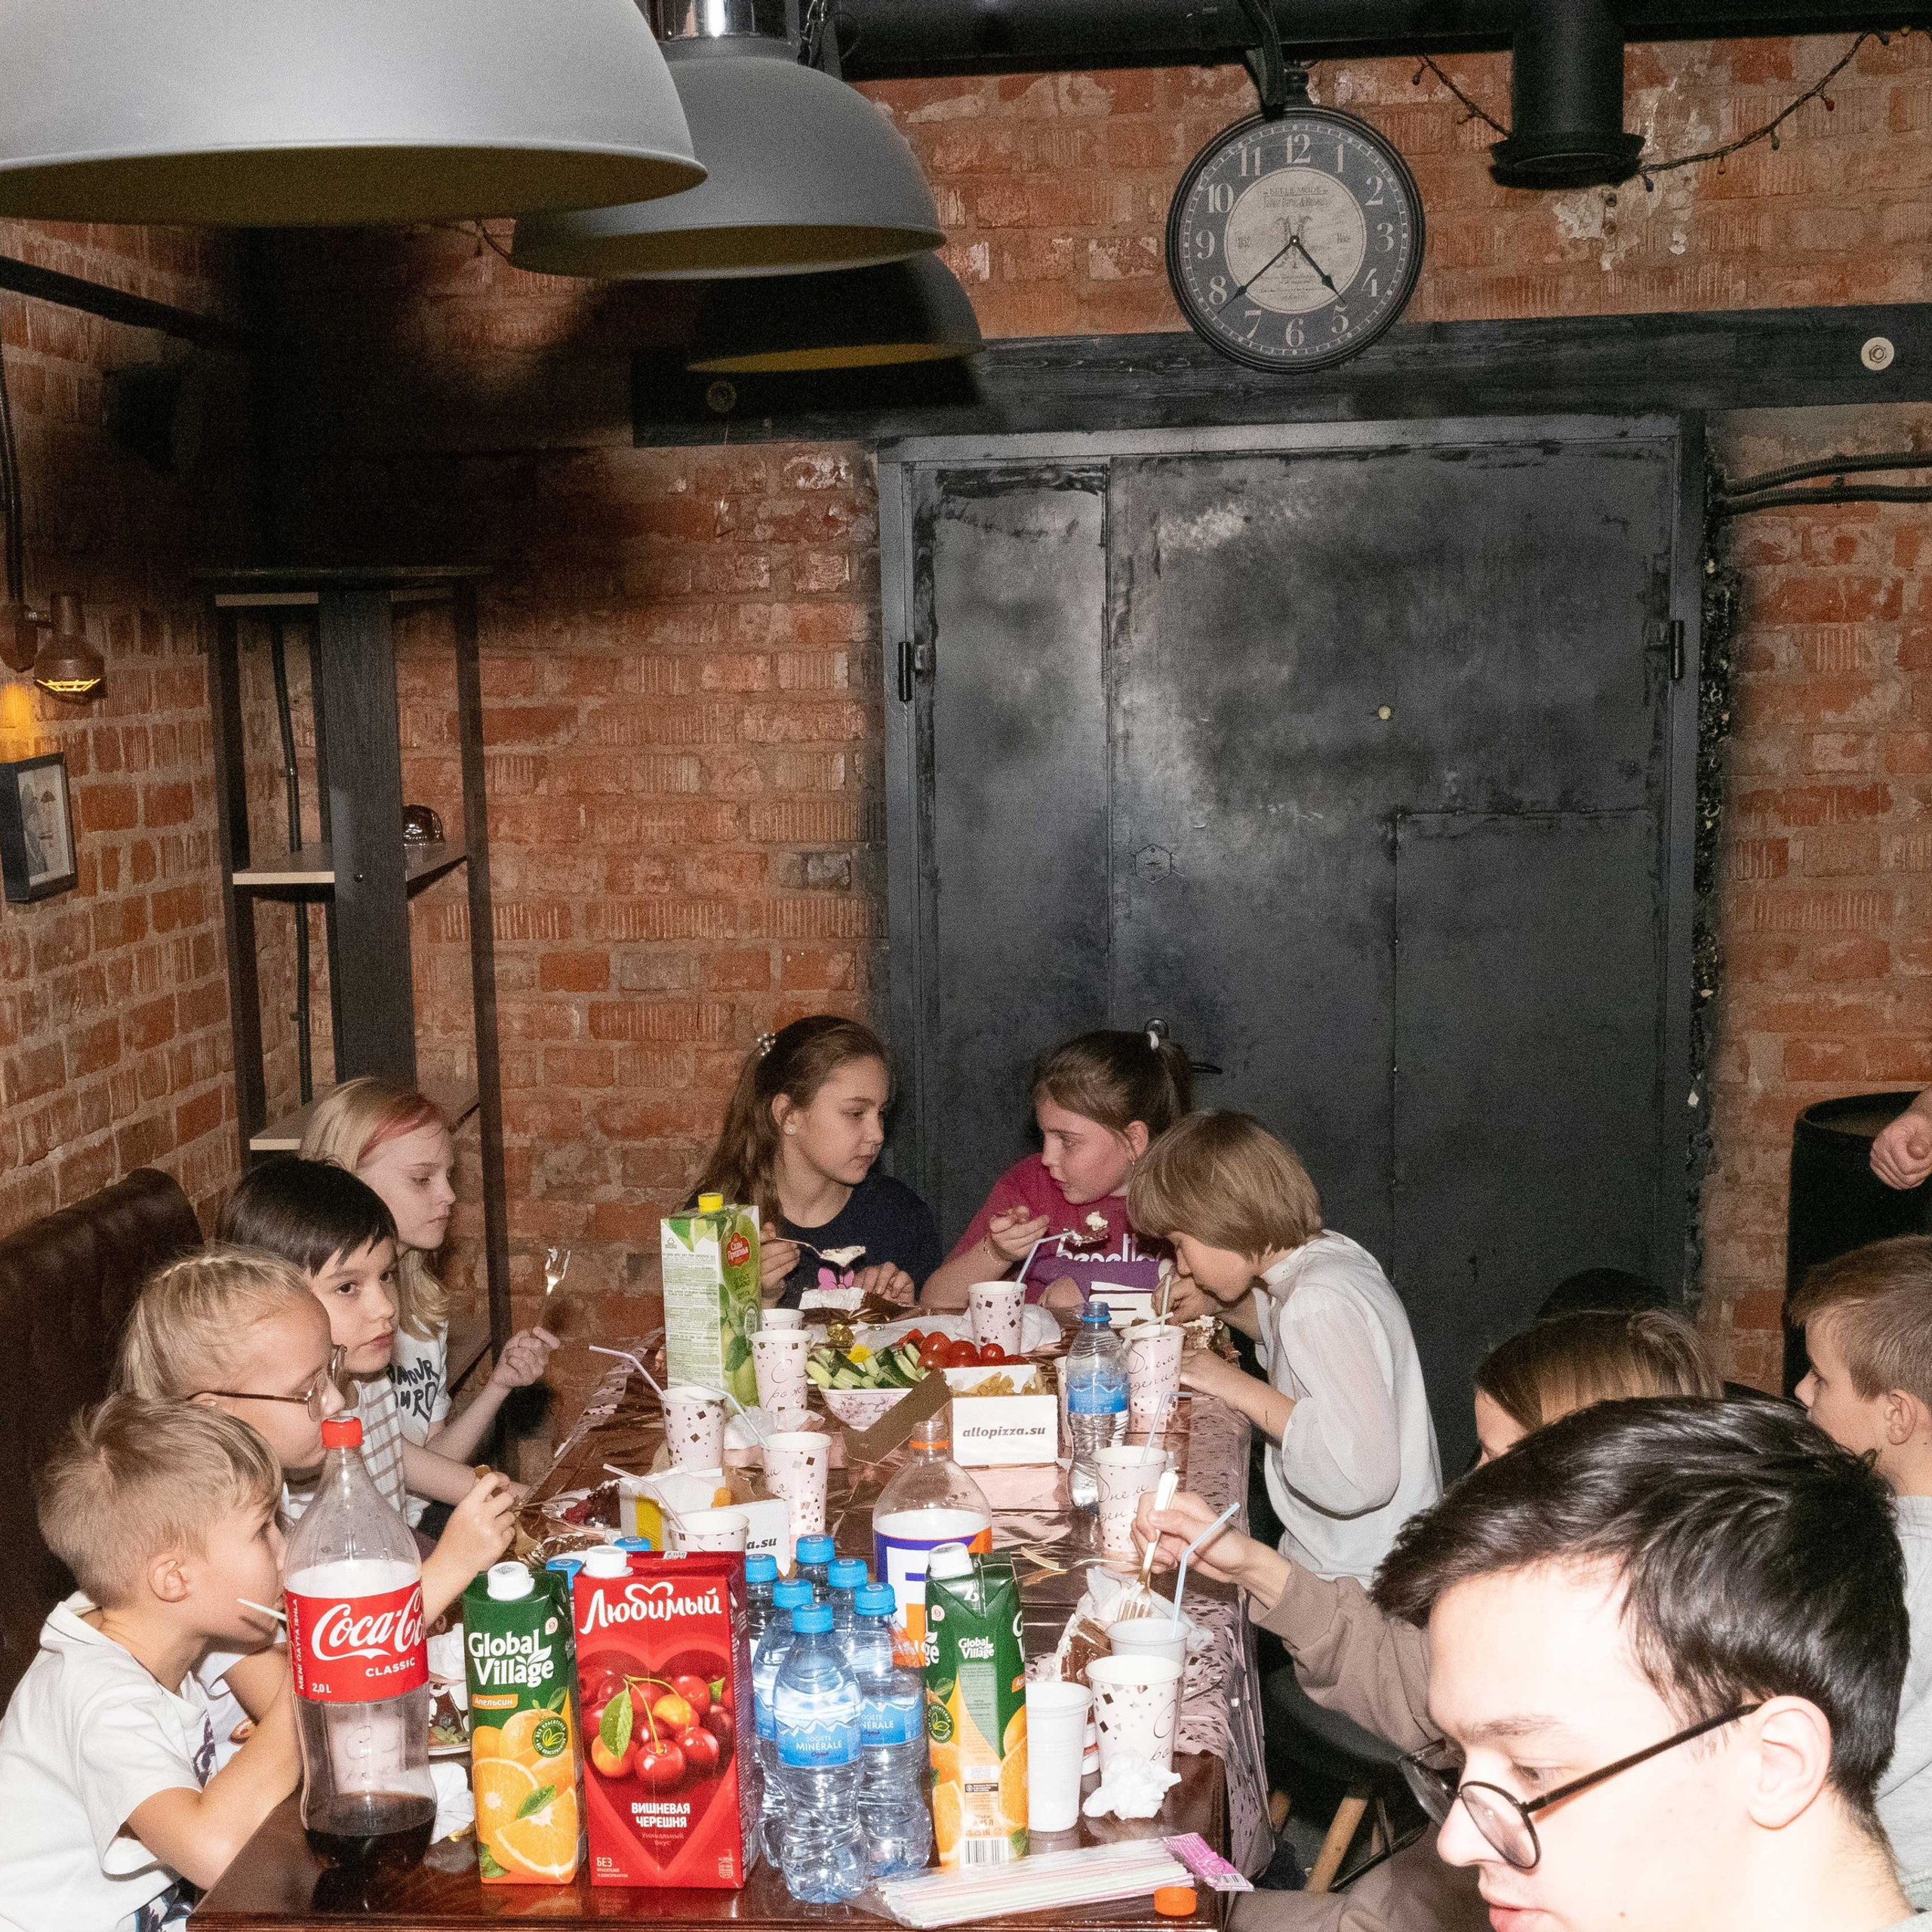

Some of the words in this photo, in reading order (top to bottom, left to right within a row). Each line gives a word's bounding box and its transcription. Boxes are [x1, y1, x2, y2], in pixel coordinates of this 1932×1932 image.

[1238, 146, 1260, 177] 11
[1286, 134, 1311, 164] 12
[1336, 143, 1344, 174] 1
[1208, 183, 1234, 213] 10
[1365, 177, 1383, 205] 2
[1196, 230, 1215, 260] 9
[1377, 223, 1393, 252] 3
[1209, 275, 1227, 305] 8
[1361, 268, 1377, 297] 4
[1245, 309, 1261, 339] 7
[1285, 318, 1304, 348] 6
[1331, 304, 1349, 334] 5
[962, 1426, 1046, 1439] allopizza.su
[746, 1537, 777, 1549] a.su
[579, 1581, 722, 1635] Любимый
[312, 1586, 425, 1661] Coca-Co
[468, 1629, 552, 1658] Global
[958, 1636, 993, 1649] Global
[961, 1647, 995, 1659] Village
[365, 1657, 416, 1677] CLASSIC
[473, 1657, 555, 1688] Village
[475, 1697, 513, 1706] Апельсин
[862, 1720, 894, 1729] NÉRALE
[631, 1802, 691, 1814] ВИШНЕВАЯ
[636, 1816, 688, 1828] ЧЕРЕШНЯ
[596, 1857, 613, 1868] БЕЗ
